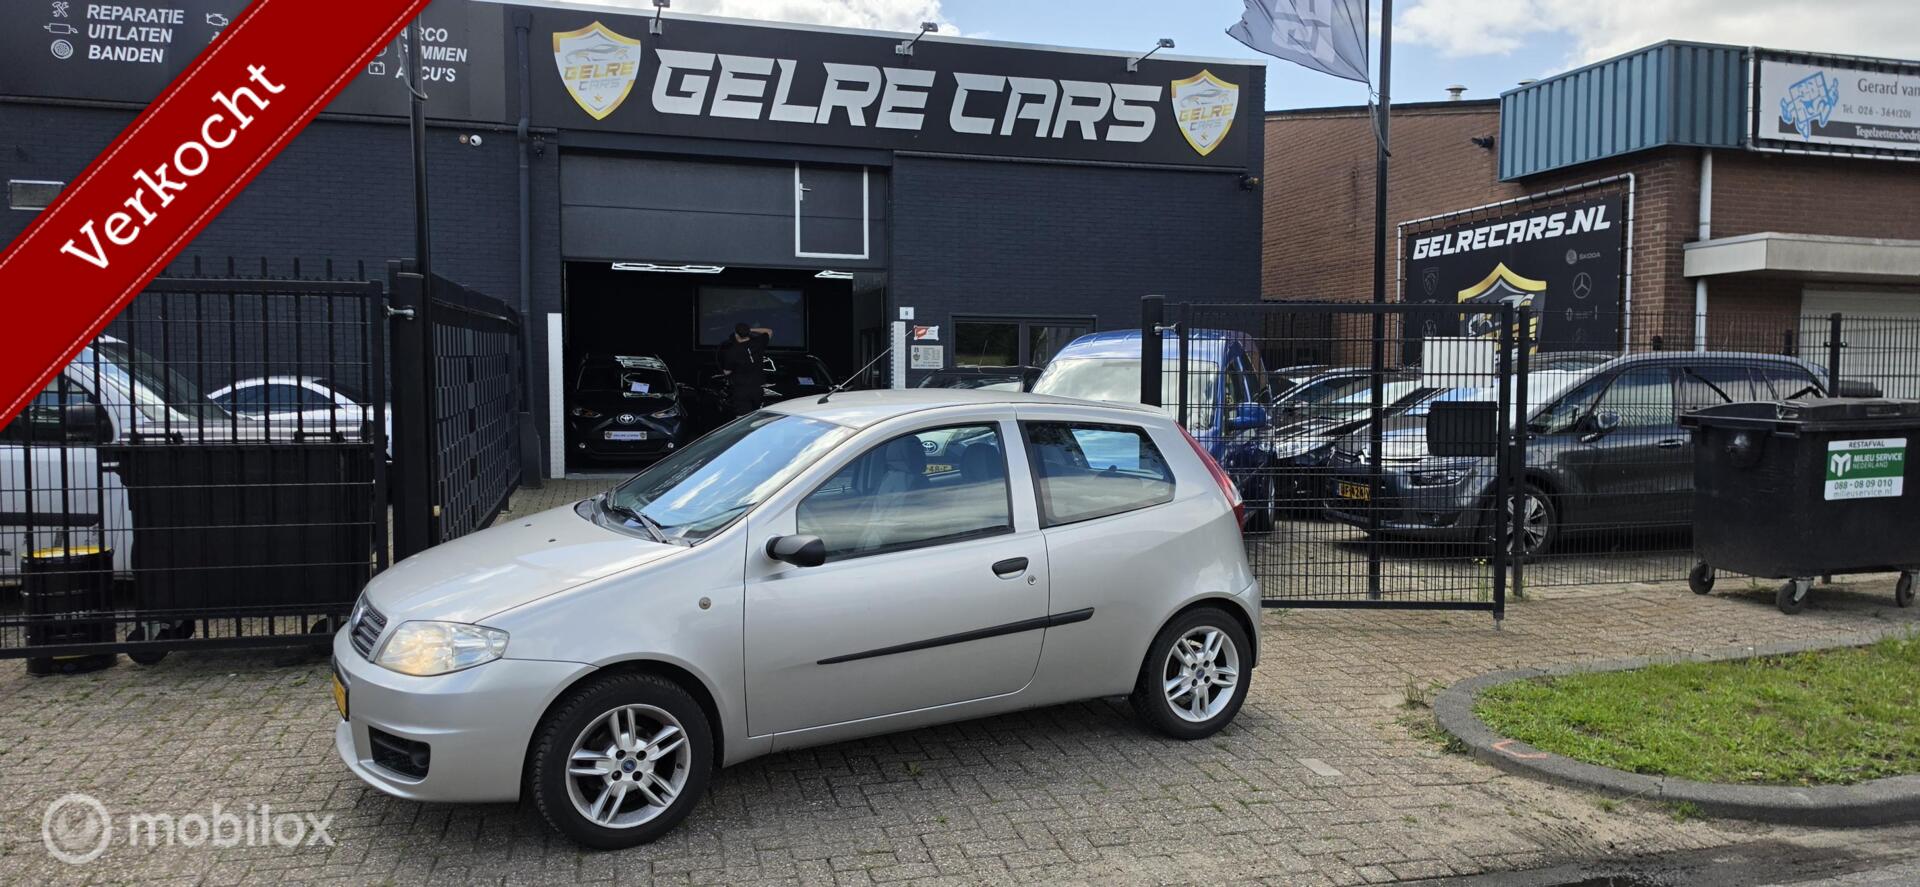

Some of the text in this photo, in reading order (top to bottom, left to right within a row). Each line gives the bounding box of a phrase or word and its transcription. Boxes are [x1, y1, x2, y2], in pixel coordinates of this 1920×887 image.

[87, 4, 185, 24] REPARATIE
[88, 23, 173, 43] UITLATEN
[400, 26, 449, 42] ARCO
[88, 44, 164, 63] BANDEN
[395, 66, 456, 82] ACU'S
[563, 61, 635, 80] GELRE
[578, 79, 620, 91] CARS
[1857, 78, 1920, 97] Gerard van
[651, 48, 1163, 143] GELRE CARS
[1179, 103, 1233, 122] GELRE
[1413, 205, 1612, 260] GELRECARS.NL
[1848, 440, 1885, 448] RESTAFVAL
[1852, 461, 1888, 469] NEDERLAND
[1853, 452, 1903, 463] MILIEU SERVICE
[1833, 488, 1893, 498] milieuservice.nl
